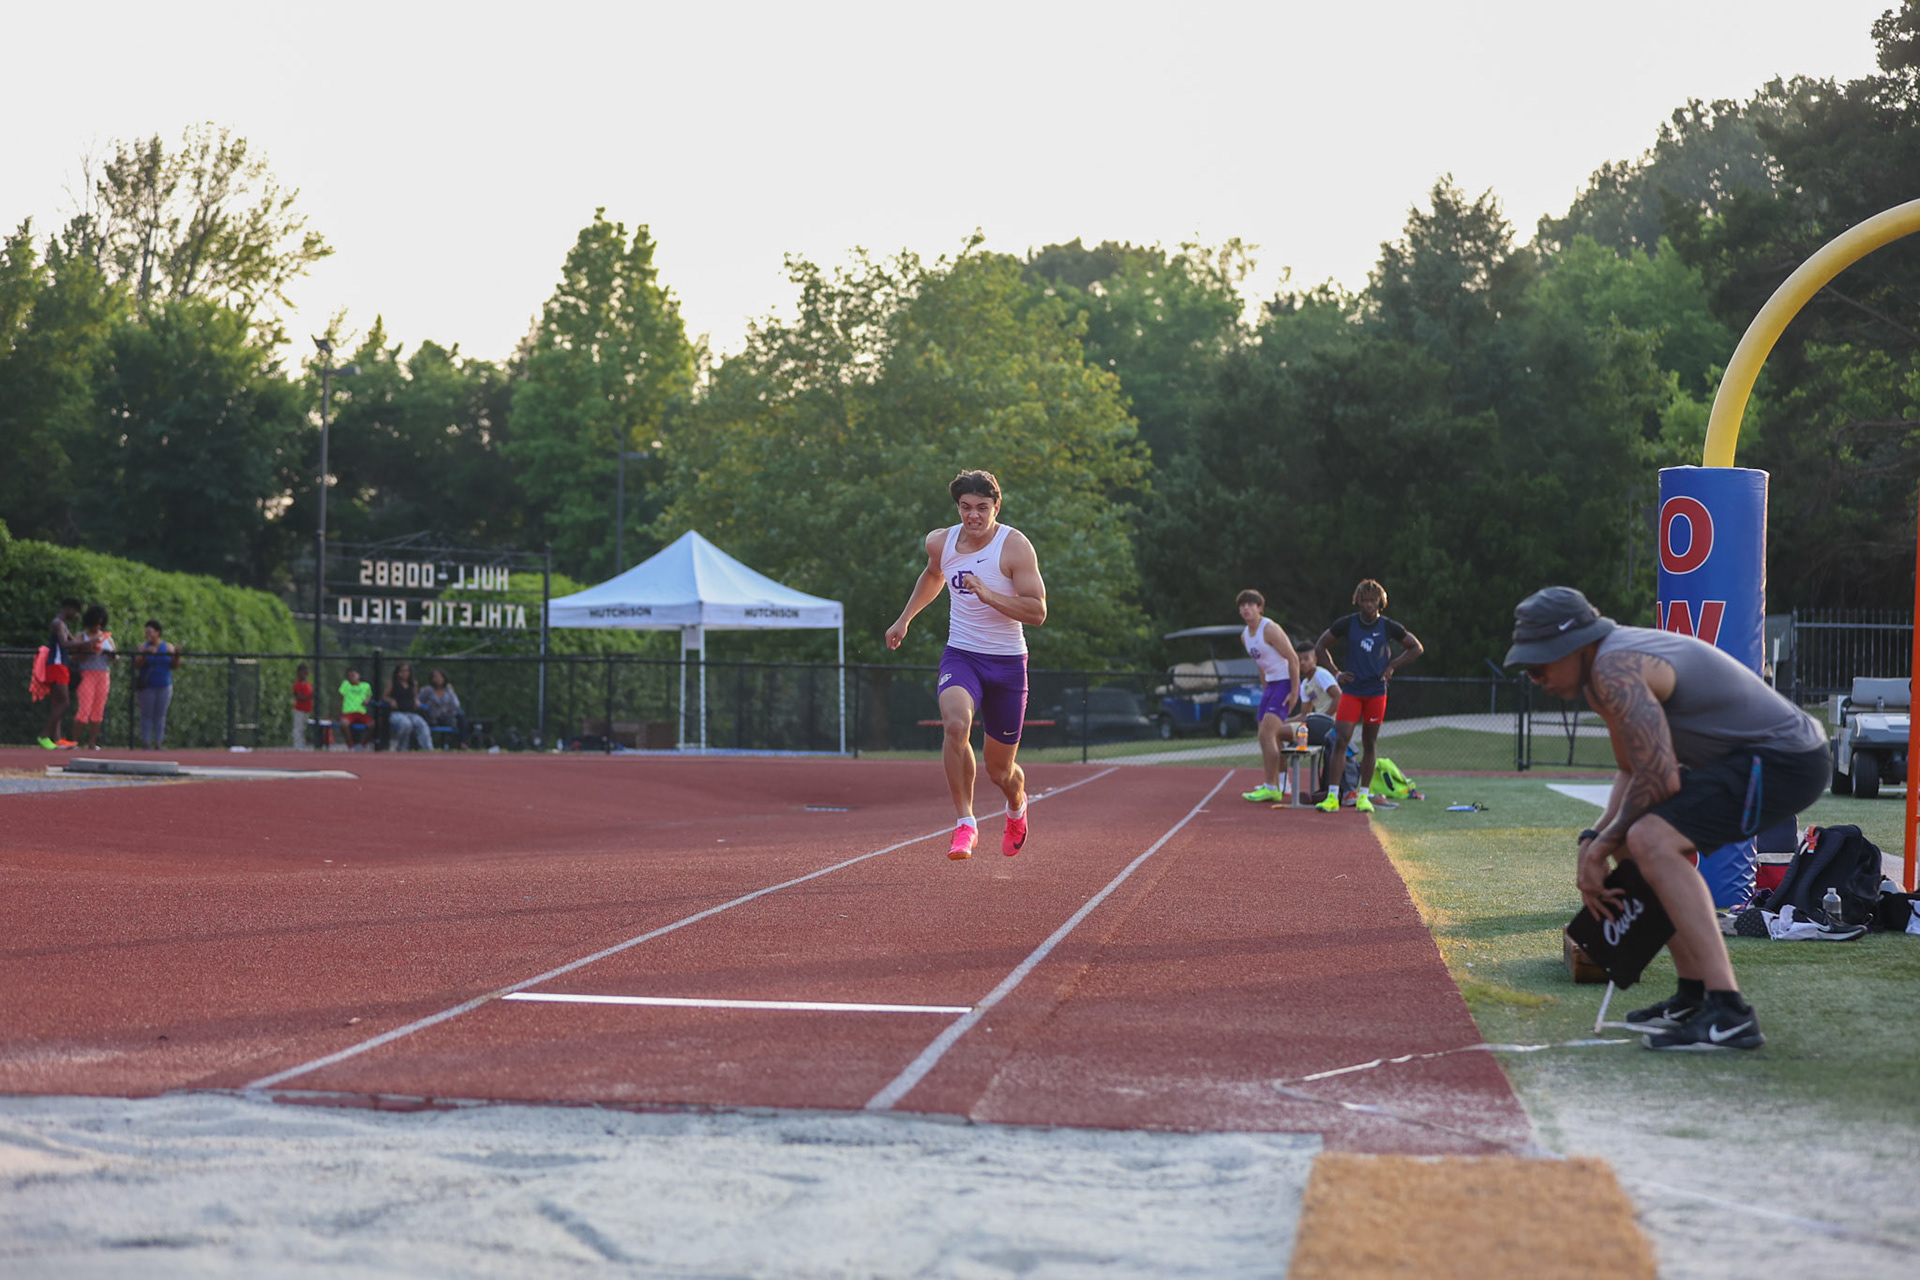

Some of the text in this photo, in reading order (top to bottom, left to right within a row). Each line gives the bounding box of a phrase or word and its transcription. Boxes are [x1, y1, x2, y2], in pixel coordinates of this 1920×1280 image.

[589, 607, 652, 618] HUTCHISON
[744, 608, 800, 618] HUTCHISON
[1603, 898, 1644, 946] Owls
